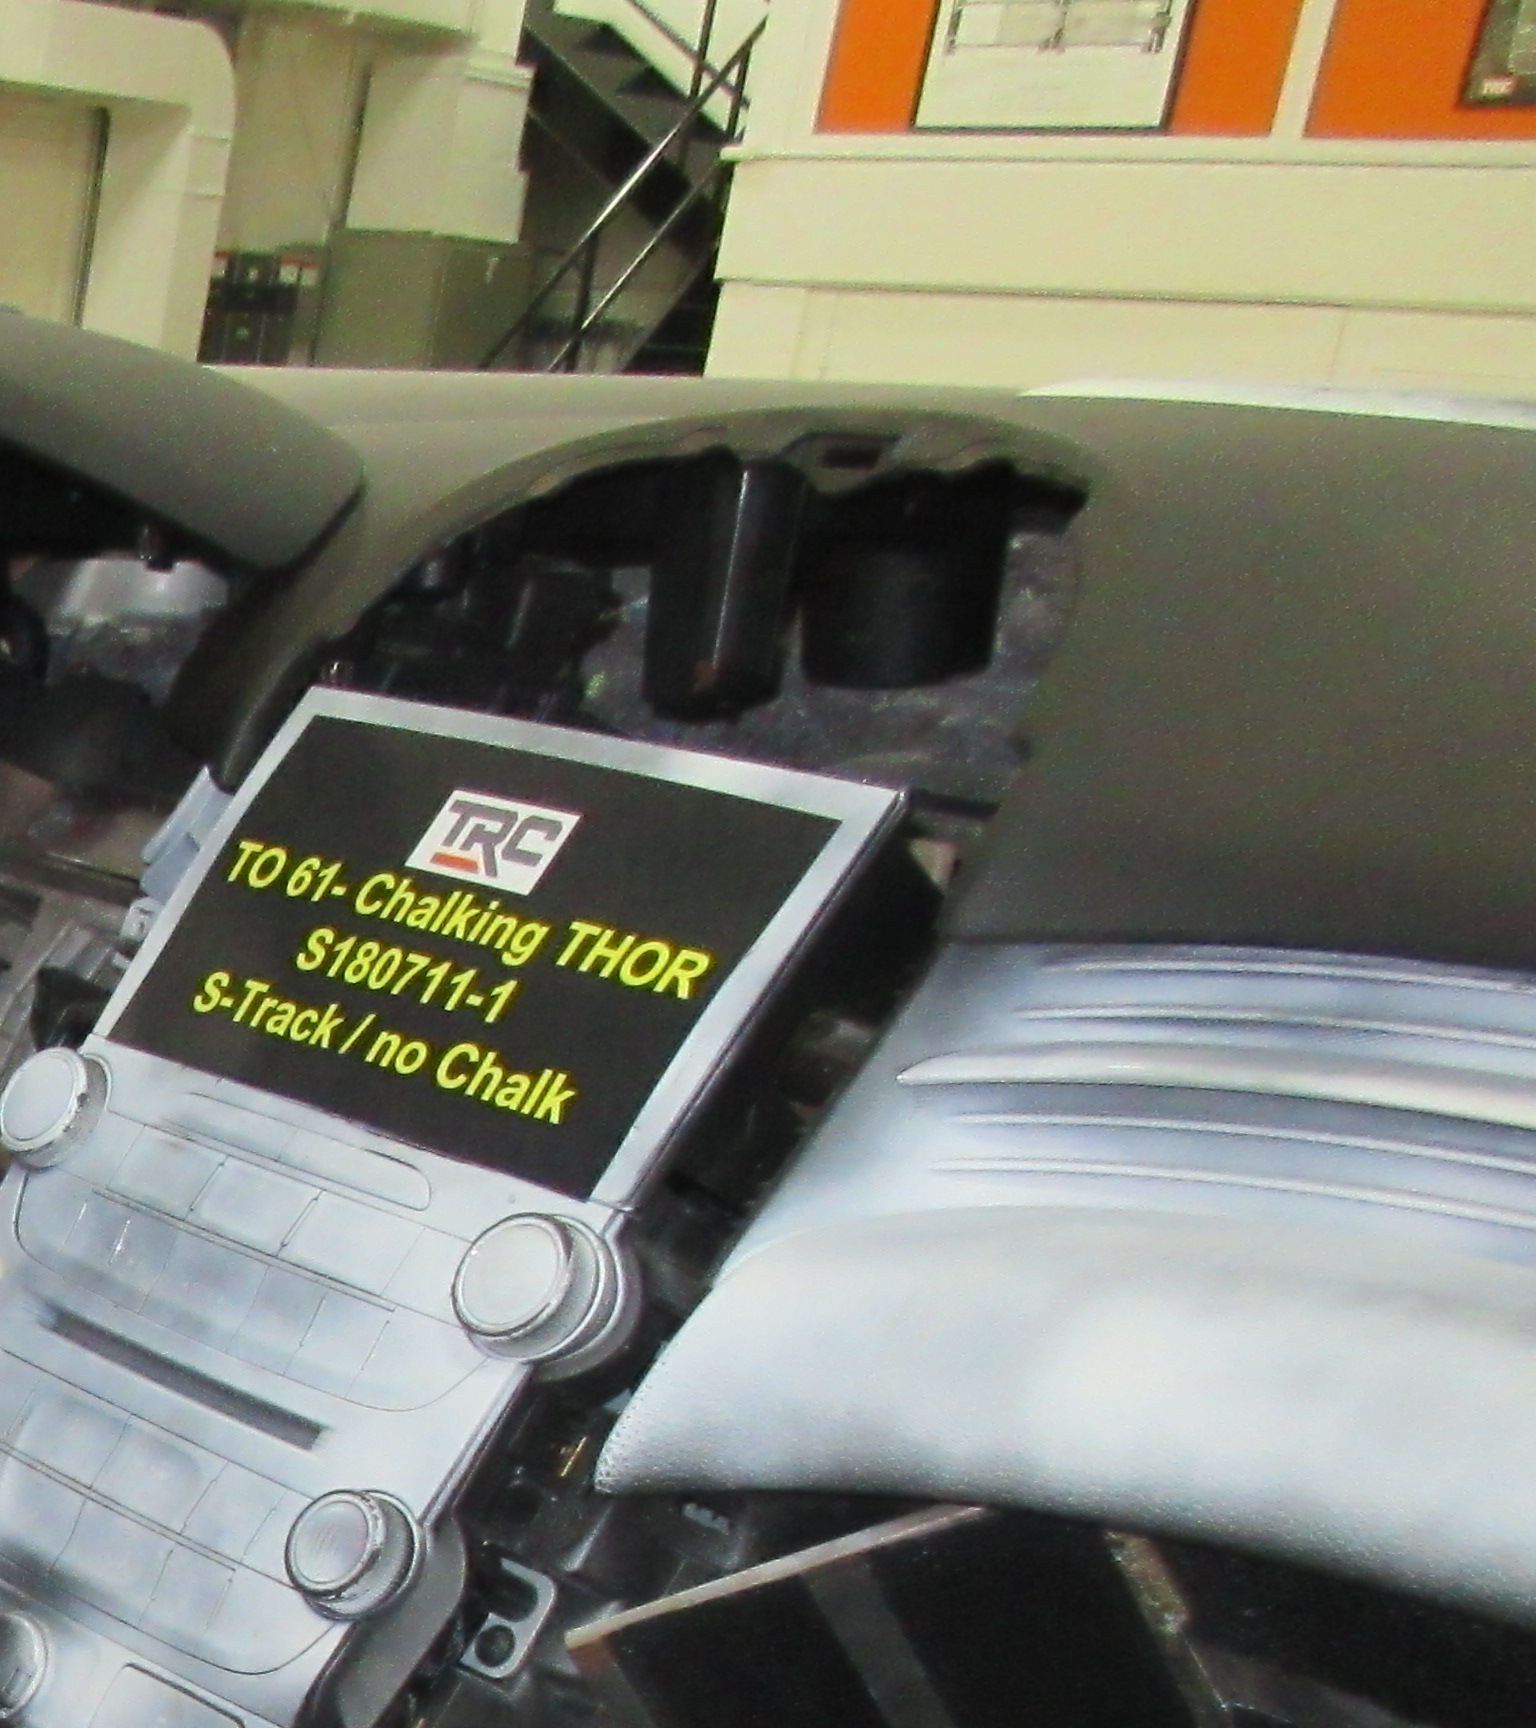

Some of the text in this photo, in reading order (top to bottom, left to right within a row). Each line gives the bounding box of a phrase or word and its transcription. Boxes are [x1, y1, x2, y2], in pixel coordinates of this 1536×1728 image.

[440, 799, 564, 878] TRC
[226, 839, 713, 1001] TO 61- Chalking THOR
[295, 926, 520, 1025] S180711-1
[192, 970, 345, 1051] S-Track
[365, 1030, 429, 1075] no
[435, 1042, 577, 1125] Chalk
